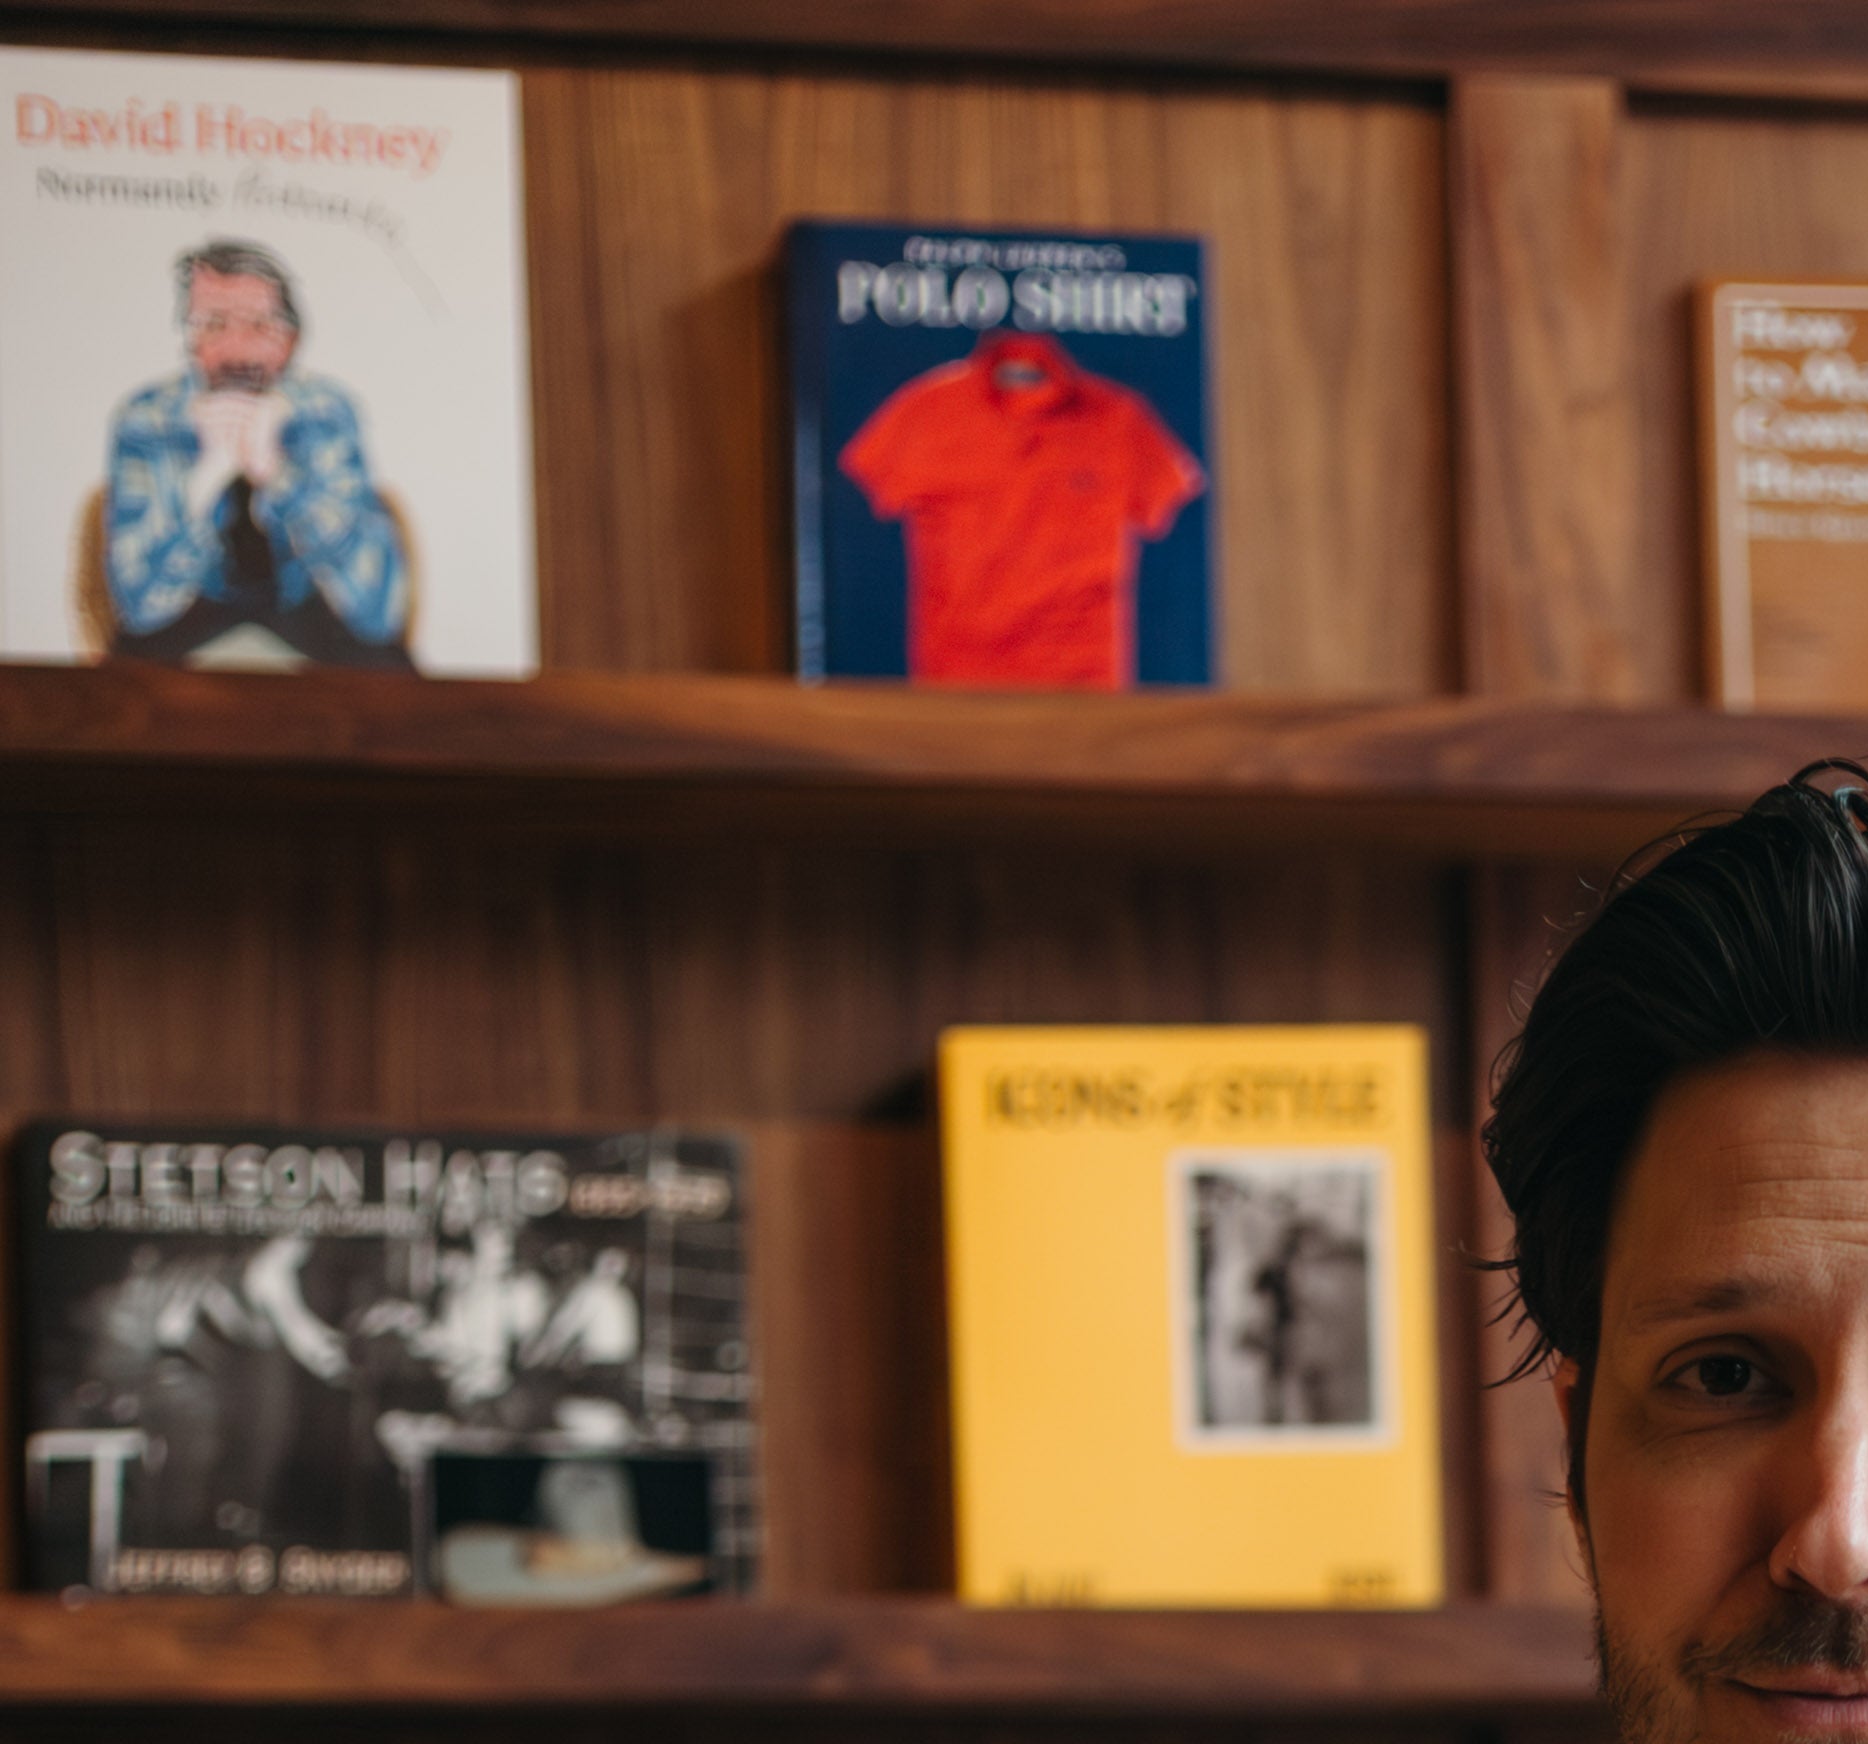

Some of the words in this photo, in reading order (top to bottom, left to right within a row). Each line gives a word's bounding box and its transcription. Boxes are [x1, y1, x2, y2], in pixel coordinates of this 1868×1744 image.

[15, 92, 183, 156] David
[193, 102, 452, 179] Hockney
[837, 260, 1010, 330] POLO
[1012, 266, 1197, 338] SHIRT
[1213, 1063, 1389, 1133] STYLE
[50, 1130, 365, 1209] STETSON
[383, 1139, 569, 1220] HATS
